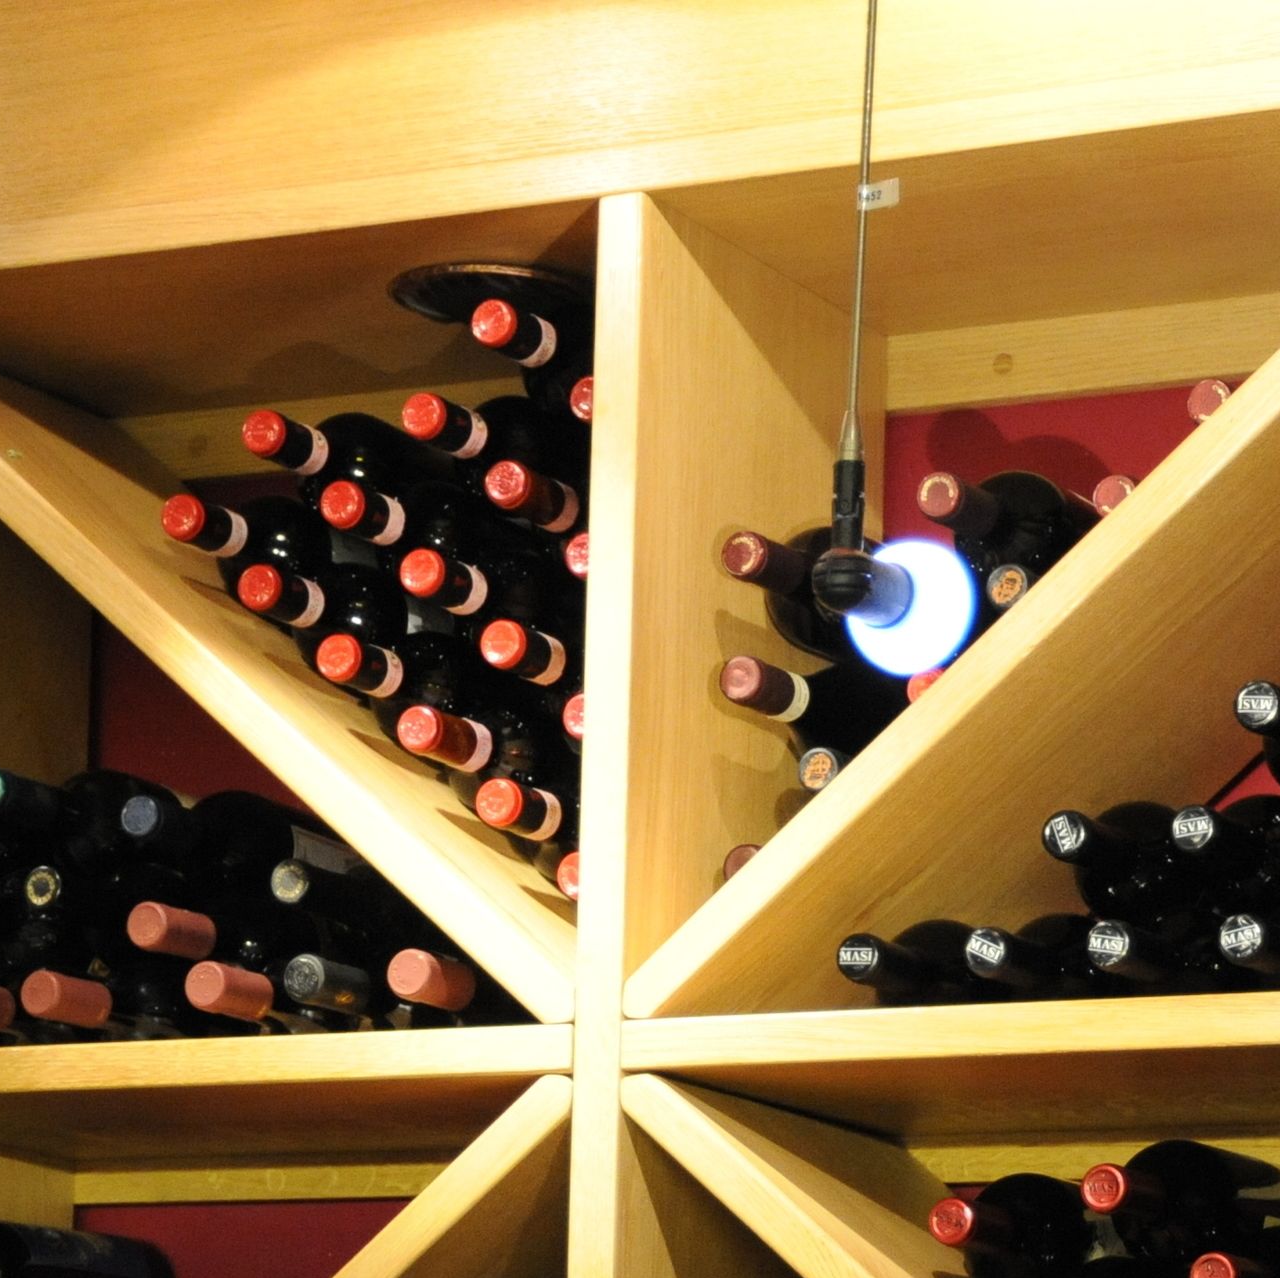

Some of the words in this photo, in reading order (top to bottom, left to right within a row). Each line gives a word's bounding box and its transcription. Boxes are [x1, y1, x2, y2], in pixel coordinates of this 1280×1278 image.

[1240, 699, 1271, 711] MASI
[1055, 816, 1074, 851] MASI
[1176, 818, 1209, 836] MASI
[969, 936, 1000, 961] MASI
[1089, 937, 1124, 951] MASI
[839, 949, 872, 962] MASI
